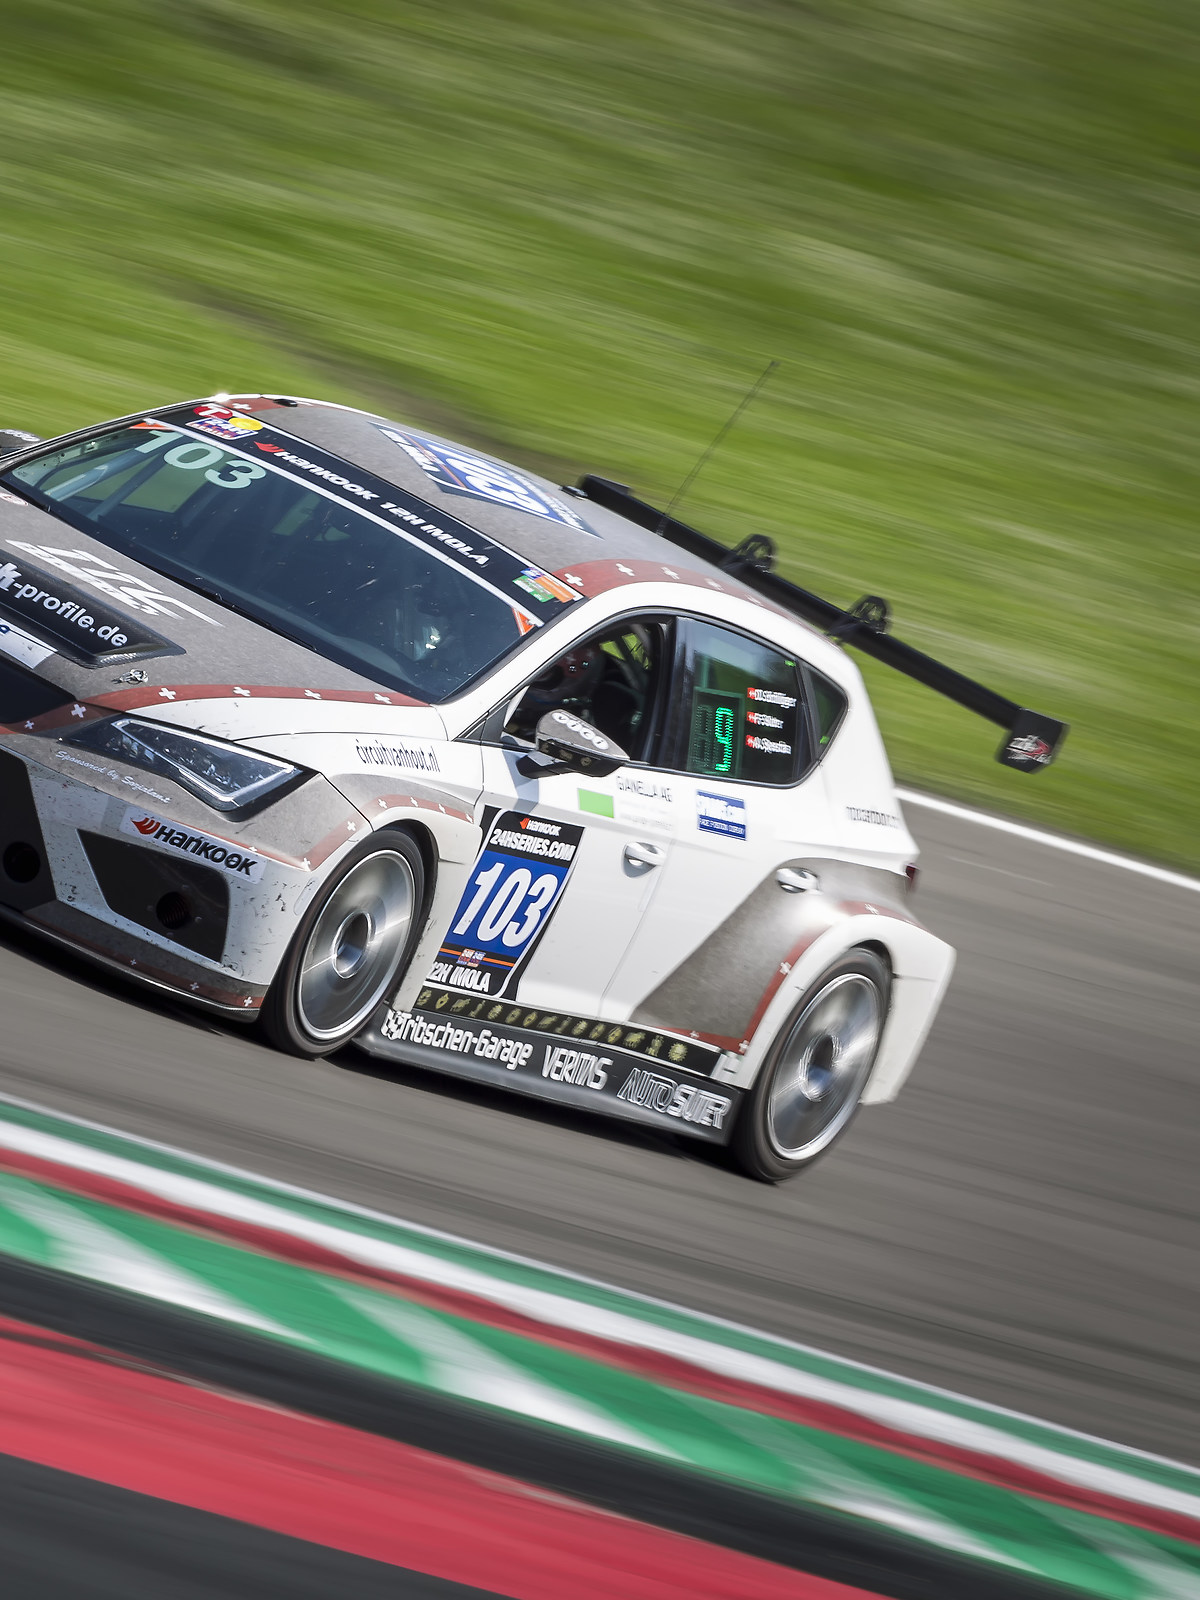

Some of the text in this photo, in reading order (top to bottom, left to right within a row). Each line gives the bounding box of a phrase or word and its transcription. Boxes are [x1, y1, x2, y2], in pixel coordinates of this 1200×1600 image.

[134, 430, 267, 489] 103
[379, 502, 427, 527] 12H
[420, 523, 490, 566] IMOLA
[355, 738, 441, 773] circuitvanhout.nl
[714, 706, 734, 772] 9
[55, 750, 171, 804] Sponsored by Sozialamt
[489, 828, 576, 862] 24HSERIES.COM
[452, 861, 559, 948] 103
[449, 967, 492, 993] IMOLA
[399, 1012, 534, 1071] Tribschen-Garage
